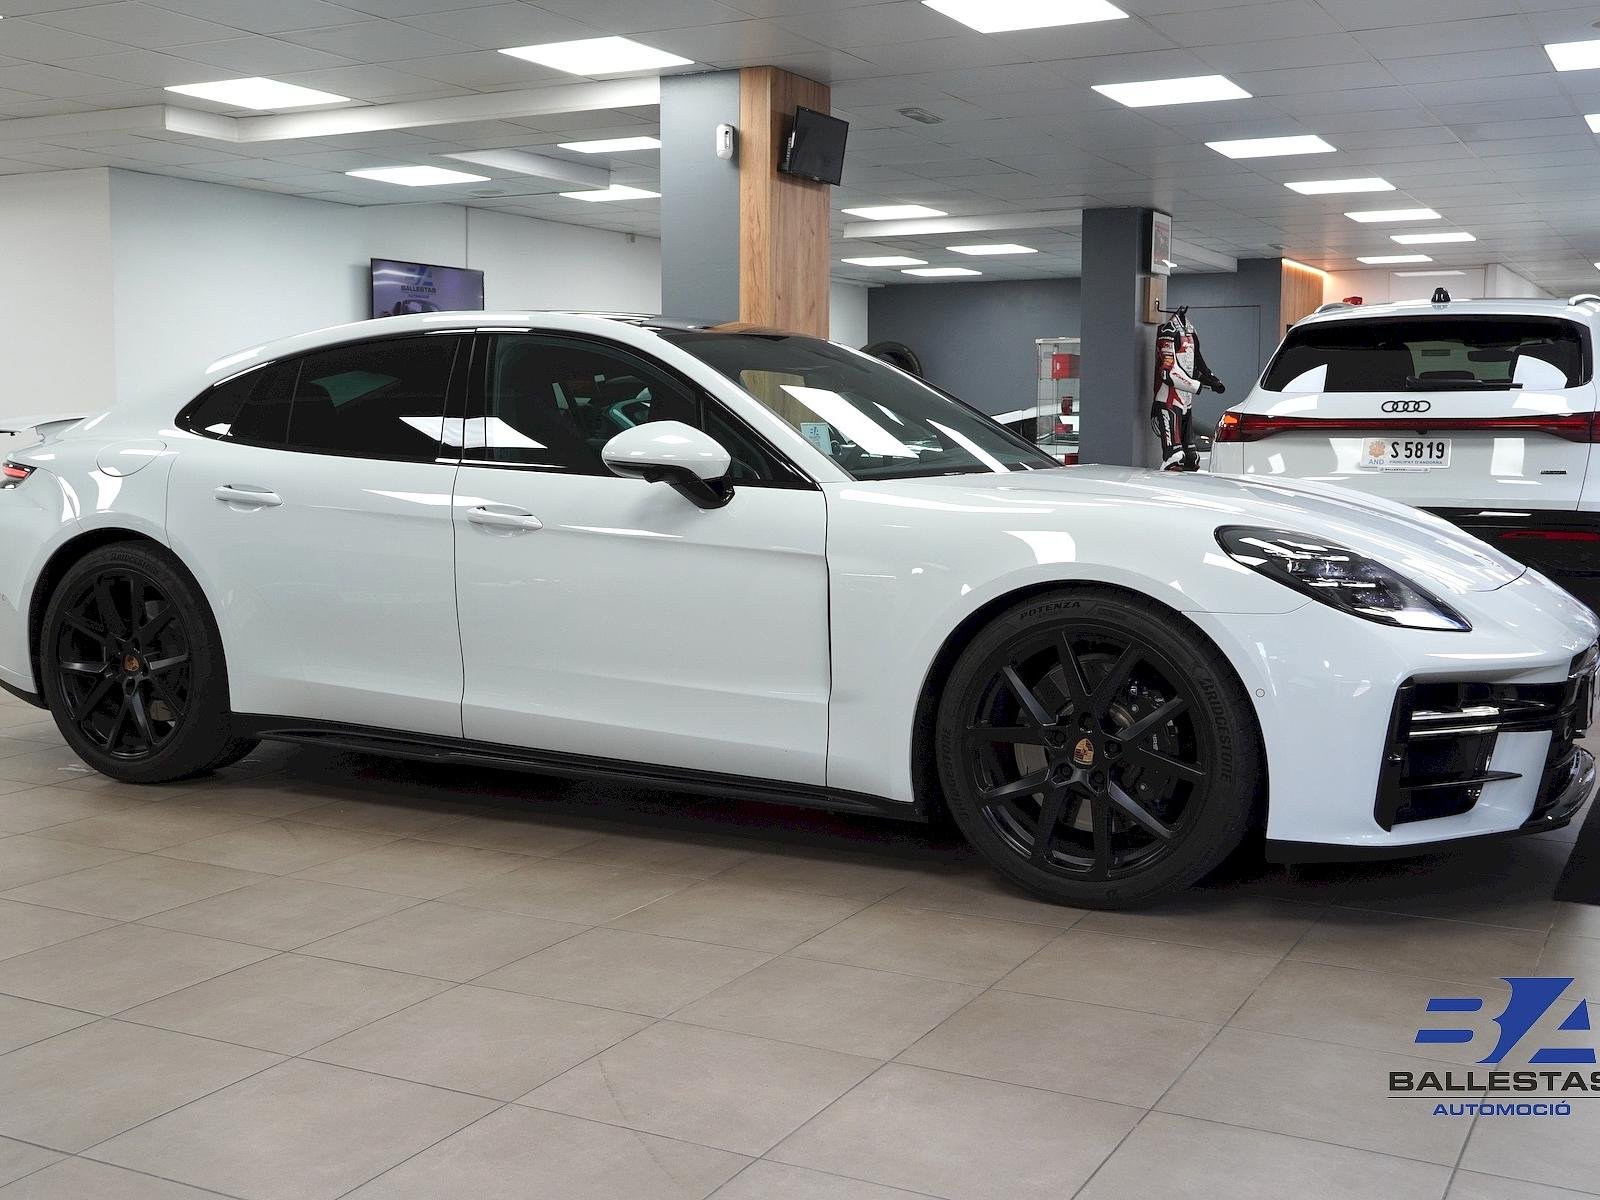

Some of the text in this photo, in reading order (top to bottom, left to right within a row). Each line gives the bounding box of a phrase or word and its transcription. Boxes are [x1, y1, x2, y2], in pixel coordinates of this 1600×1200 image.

[1390, 441, 1445, 460] S 5819
[1020, 601, 1081, 620] POTENZA
